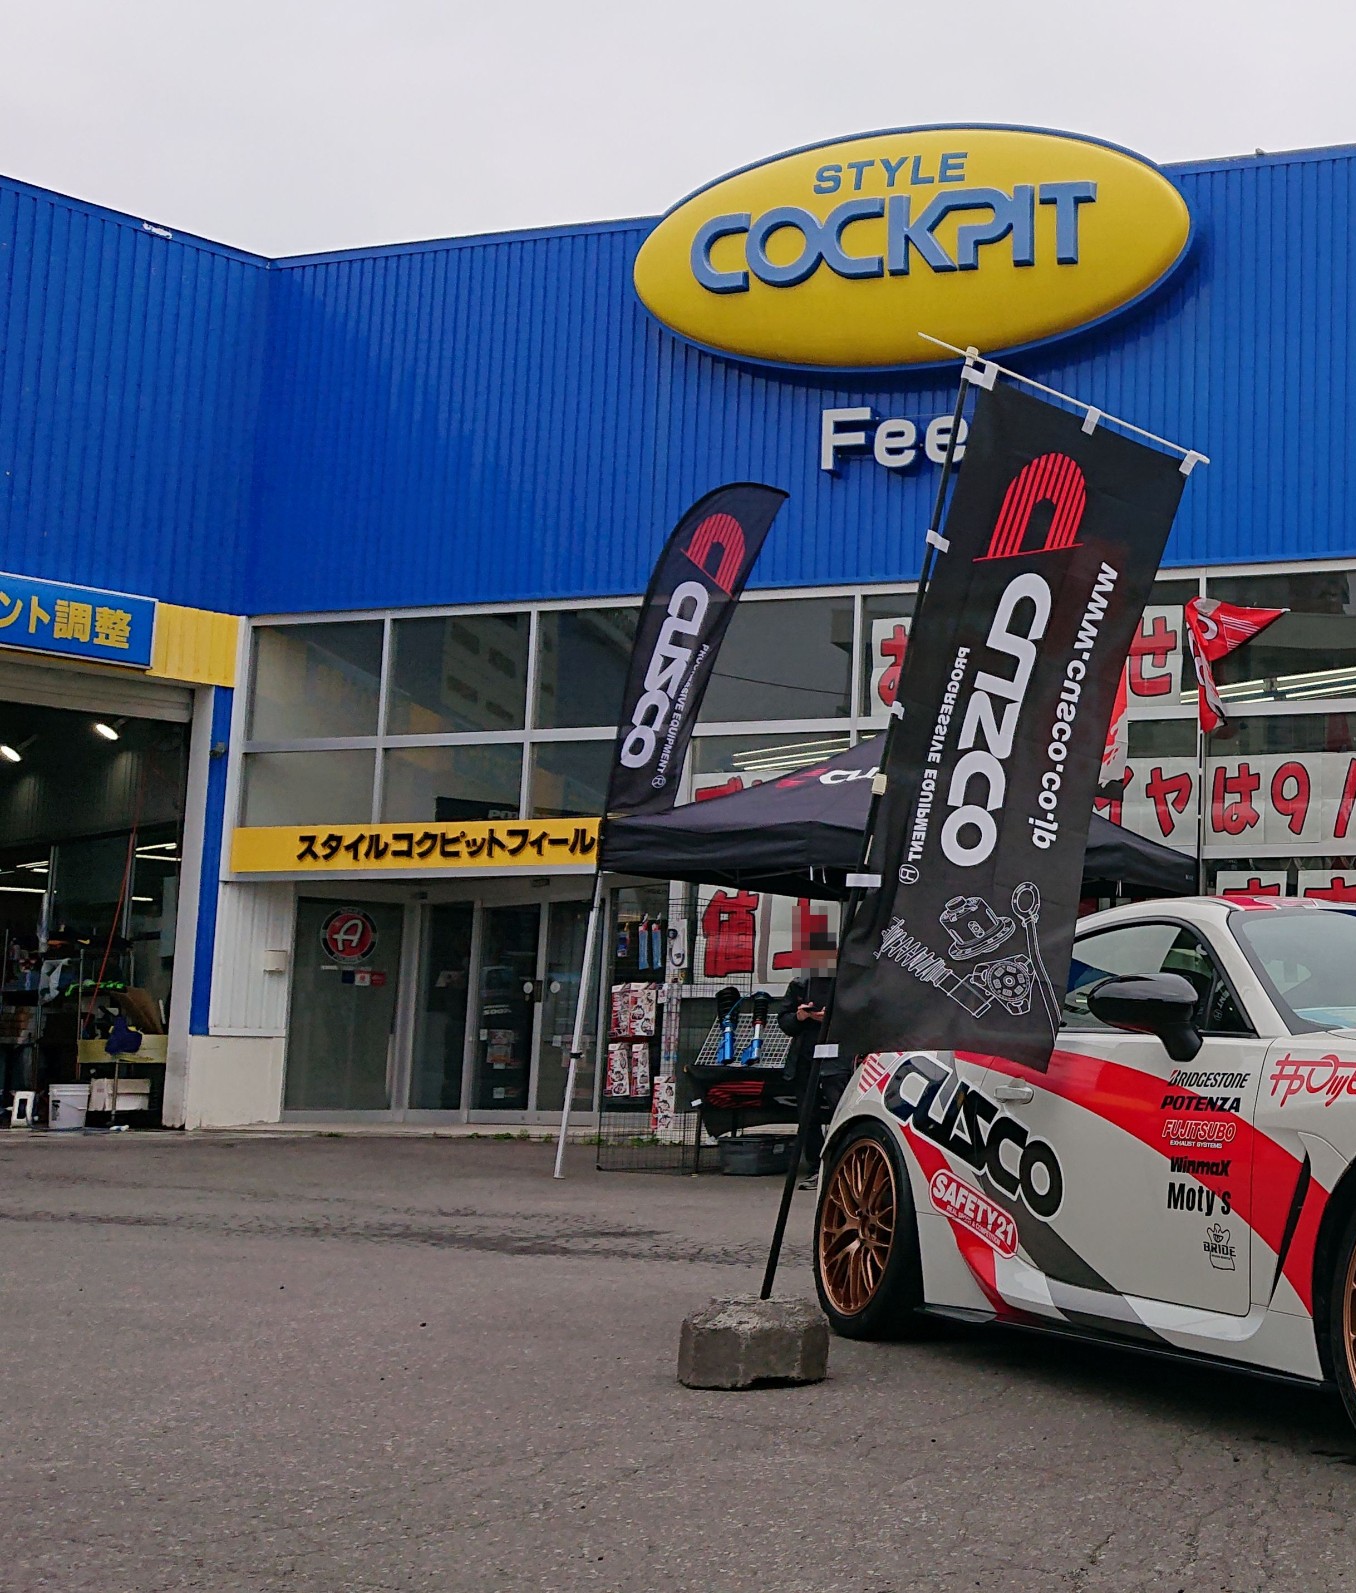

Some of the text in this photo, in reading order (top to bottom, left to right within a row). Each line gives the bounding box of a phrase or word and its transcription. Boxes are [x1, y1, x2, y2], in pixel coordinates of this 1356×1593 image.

[813, 152, 968, 194] STYLE
[690, 180, 1097, 294] COCKPIT
[620, 581, 709, 769] CUSCO
[656, 710, 682, 774] EQUIPMENT
[297, 828, 596, 861] スタイルコクピットフィール
[1168, 1070, 1251, 1089] BRIDGESTONE
[1161, 1095, 1241, 1113] POTENZA
[884, 1054, 1064, 1221] CUSCO
[1162, 1120, 1236, 1142] FUJITSUBO
[1167, 1182, 1231, 1216] Moty's
[1203, 1241, 1236, 1257] BRIDE
